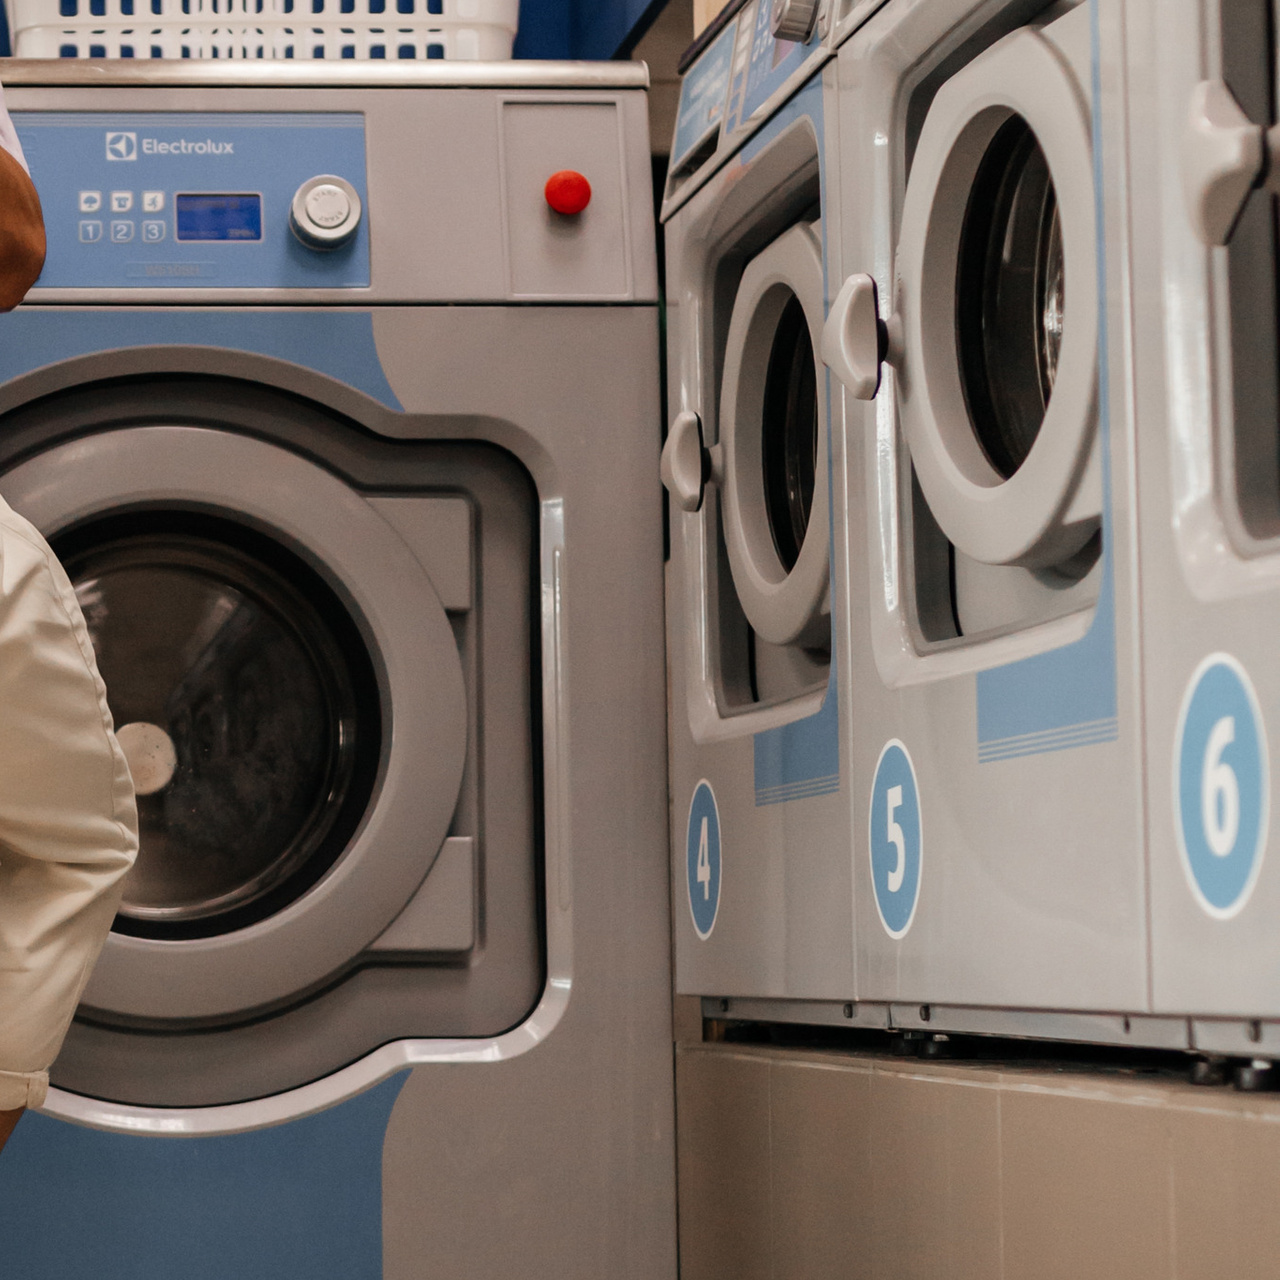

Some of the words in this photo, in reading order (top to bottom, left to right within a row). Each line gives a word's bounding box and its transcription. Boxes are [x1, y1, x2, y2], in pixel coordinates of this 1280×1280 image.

[142, 138, 234, 154] Electrolux
[86, 224, 94, 239] 1
[115, 224, 127, 239] 2
[147, 224, 159, 239] 3
[1201, 715, 1241, 859] 6
[696, 816, 711, 902] 4
[886, 784, 906, 893] 5
